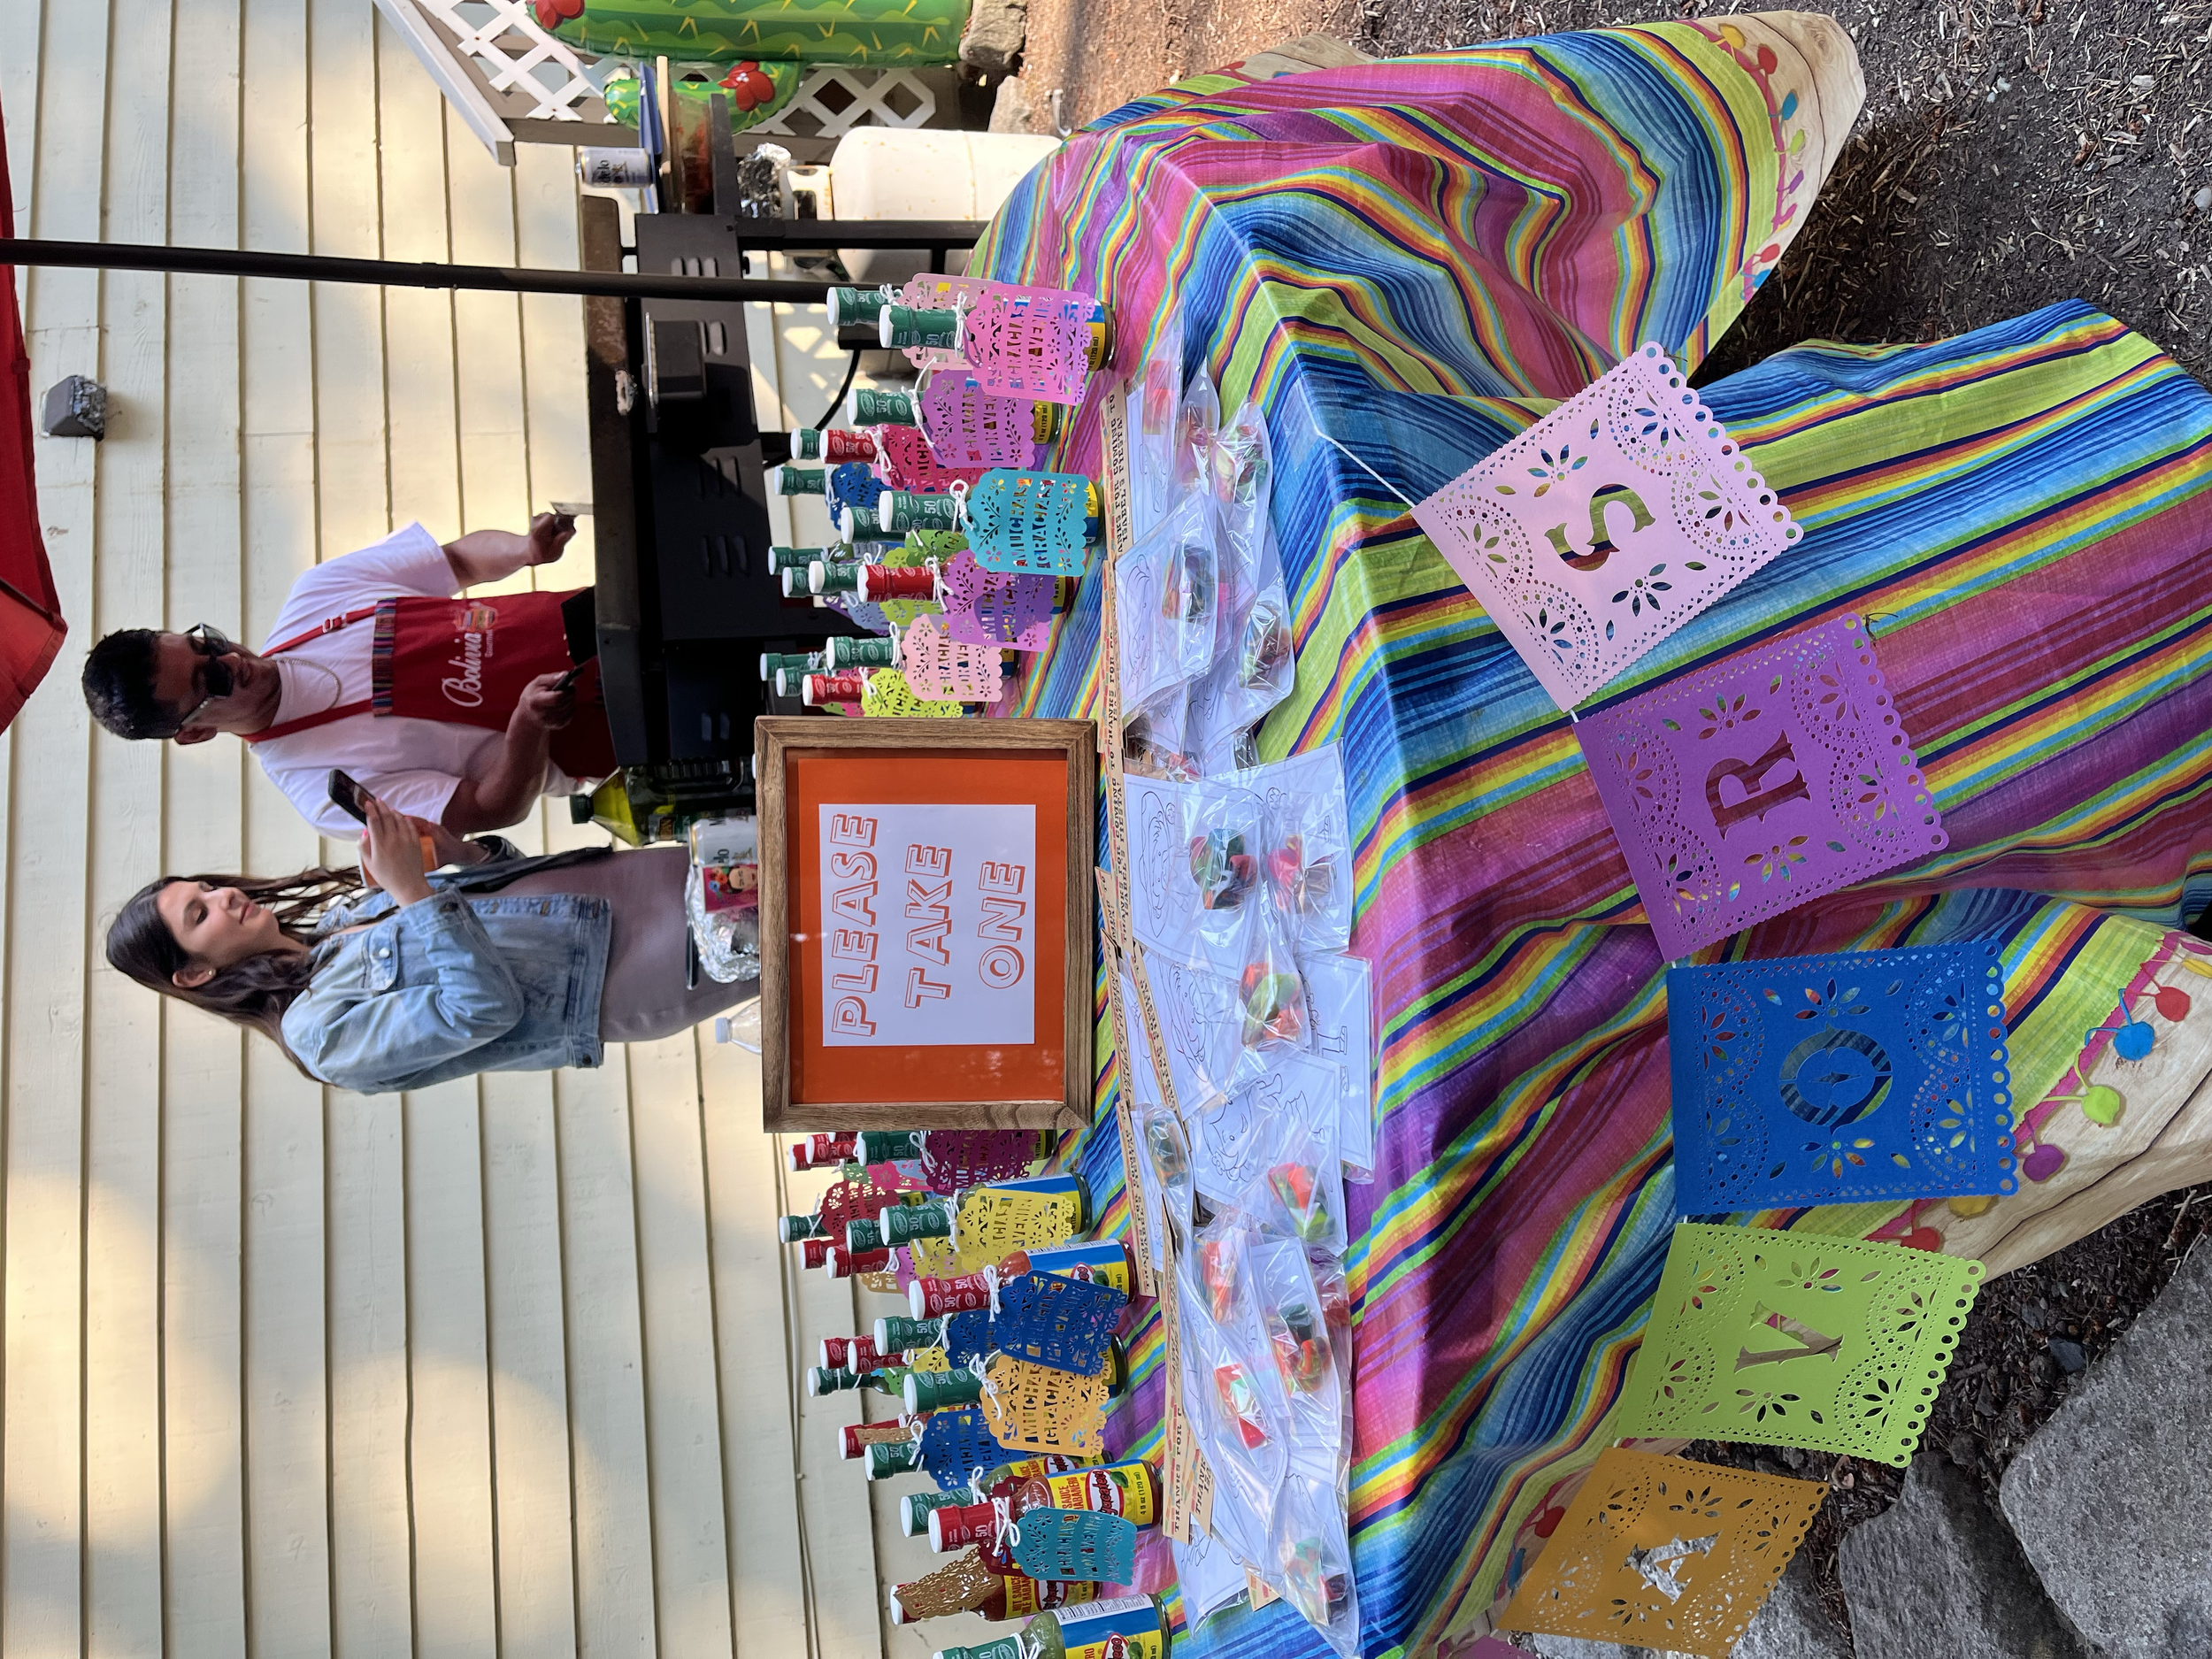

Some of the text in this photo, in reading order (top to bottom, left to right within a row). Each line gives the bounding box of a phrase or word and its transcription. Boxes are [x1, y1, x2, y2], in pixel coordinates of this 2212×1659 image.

[926, 334, 940, 345] 50
[1006, 306, 1025, 378] GRACIAS
[1029, 299, 1051, 389] POR VENIR
[1089, 348, 1098, 360] (120
[876, 399, 887, 413] 50
[1110, 394, 1116, 414] TO
[1110, 418, 1119, 475] COMING
[1116, 415, 1128, 541] ISABEL'S FIESTA!
[923, 500, 936, 514] 50
[1010, 484, 1028, 560] MUCHAS
[1033, 484, 1053, 564] GRACIAS
[1115, 515, 1124, 554] ANKS
[1544, 483, 1656, 572] S
[981, 573, 998, 634] MUCHA
[1002, 575, 1021, 637] GRACIA
[442, 632, 483, 707] Bolivia
[1110, 751, 1116, 771] TO
[1705, 728, 1812, 841] R
[1111, 777, 1120, 839] COMING
[1117, 781, 1125, 842] FIESTA!
[830, 813, 879, 1037] PLEASE
[904, 843, 953, 1009] TAKE
[977, 861, 1026, 989] ONE
[1118, 880, 1128, 943] THANKS
[893, 1145, 904, 1156] 50
[909, 1217, 919, 1231] 50
[954, 1279, 968, 1290] 50
[1138, 1228, 1150, 1290] THANKS
[917, 1323, 928, 1333] 50
[944, 1296, 956, 1308] 50
[1732, 1300, 1844, 1376] V
[935, 1373, 946, 1385] 50
[1023, 1363, 1042, 1437] MUCHAS
[890, 1447, 900, 1458] 50
[939, 1492, 951, 1501] 50
[1058, 1486, 1073, 1509] SAUCE
[1066, 1477, 1084, 1510] HABANERO
[1136, 1481, 1145, 1495] (120
[1194, 1456, 1209, 1515] THANK
[975, 1525, 987, 1538] 50
[1010, 1577, 1022, 1599] SAUCE
[1021, 1577, 1033, 1601] HABAN
[1617, 1529, 1722, 1606] A
